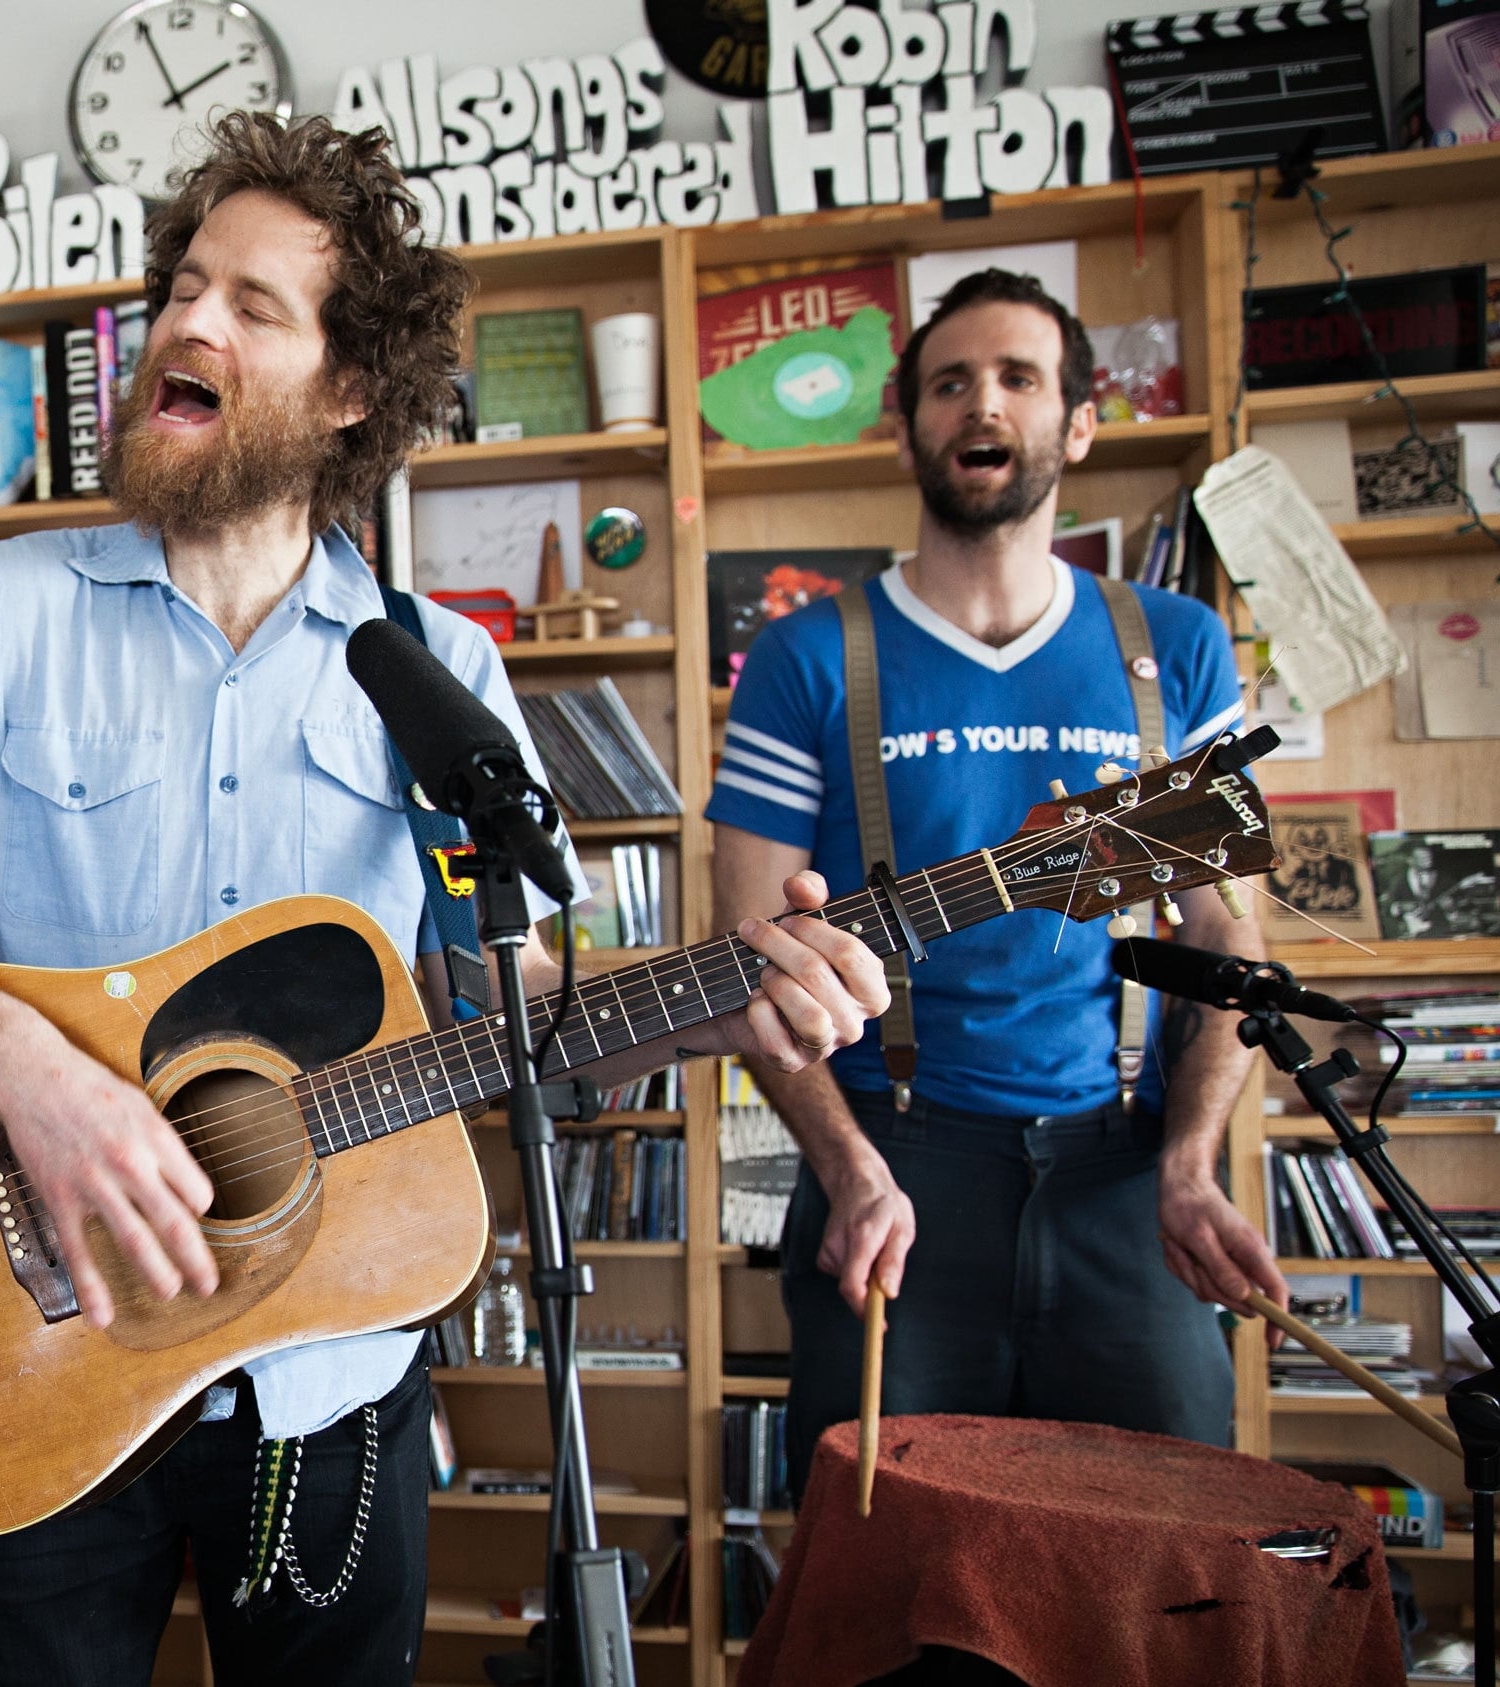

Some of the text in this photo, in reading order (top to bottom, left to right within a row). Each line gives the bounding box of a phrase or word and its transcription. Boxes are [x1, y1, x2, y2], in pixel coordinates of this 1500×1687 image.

[169, 8, 194, 29] 12
[216, 18, 225, 37] 1
[238, 43, 258, 65] 2
[768, 0, 1037, 92] Robin
[104, 53, 125, 72] 10
[91, 92, 109, 113] 9
[250, 82, 268, 103] 3
[334, 38, 665, 177] Allsongs
[100, 131, 119, 151] 8
[769, 75, 1112, 214] Hilton
[127, 158, 143, 179] 7
[397, 102, 759, 246] onsidered
[760, 286, 830, 336] LED
[67, 401, 101, 491] REED
[879, 726, 1141, 763] OW'S YOUR NEWS
[1204, 773, 1264, 836] Gibson
[1011, 851, 1080, 882] Blue Ridge
[1376, 1515, 1427, 1537] IND
